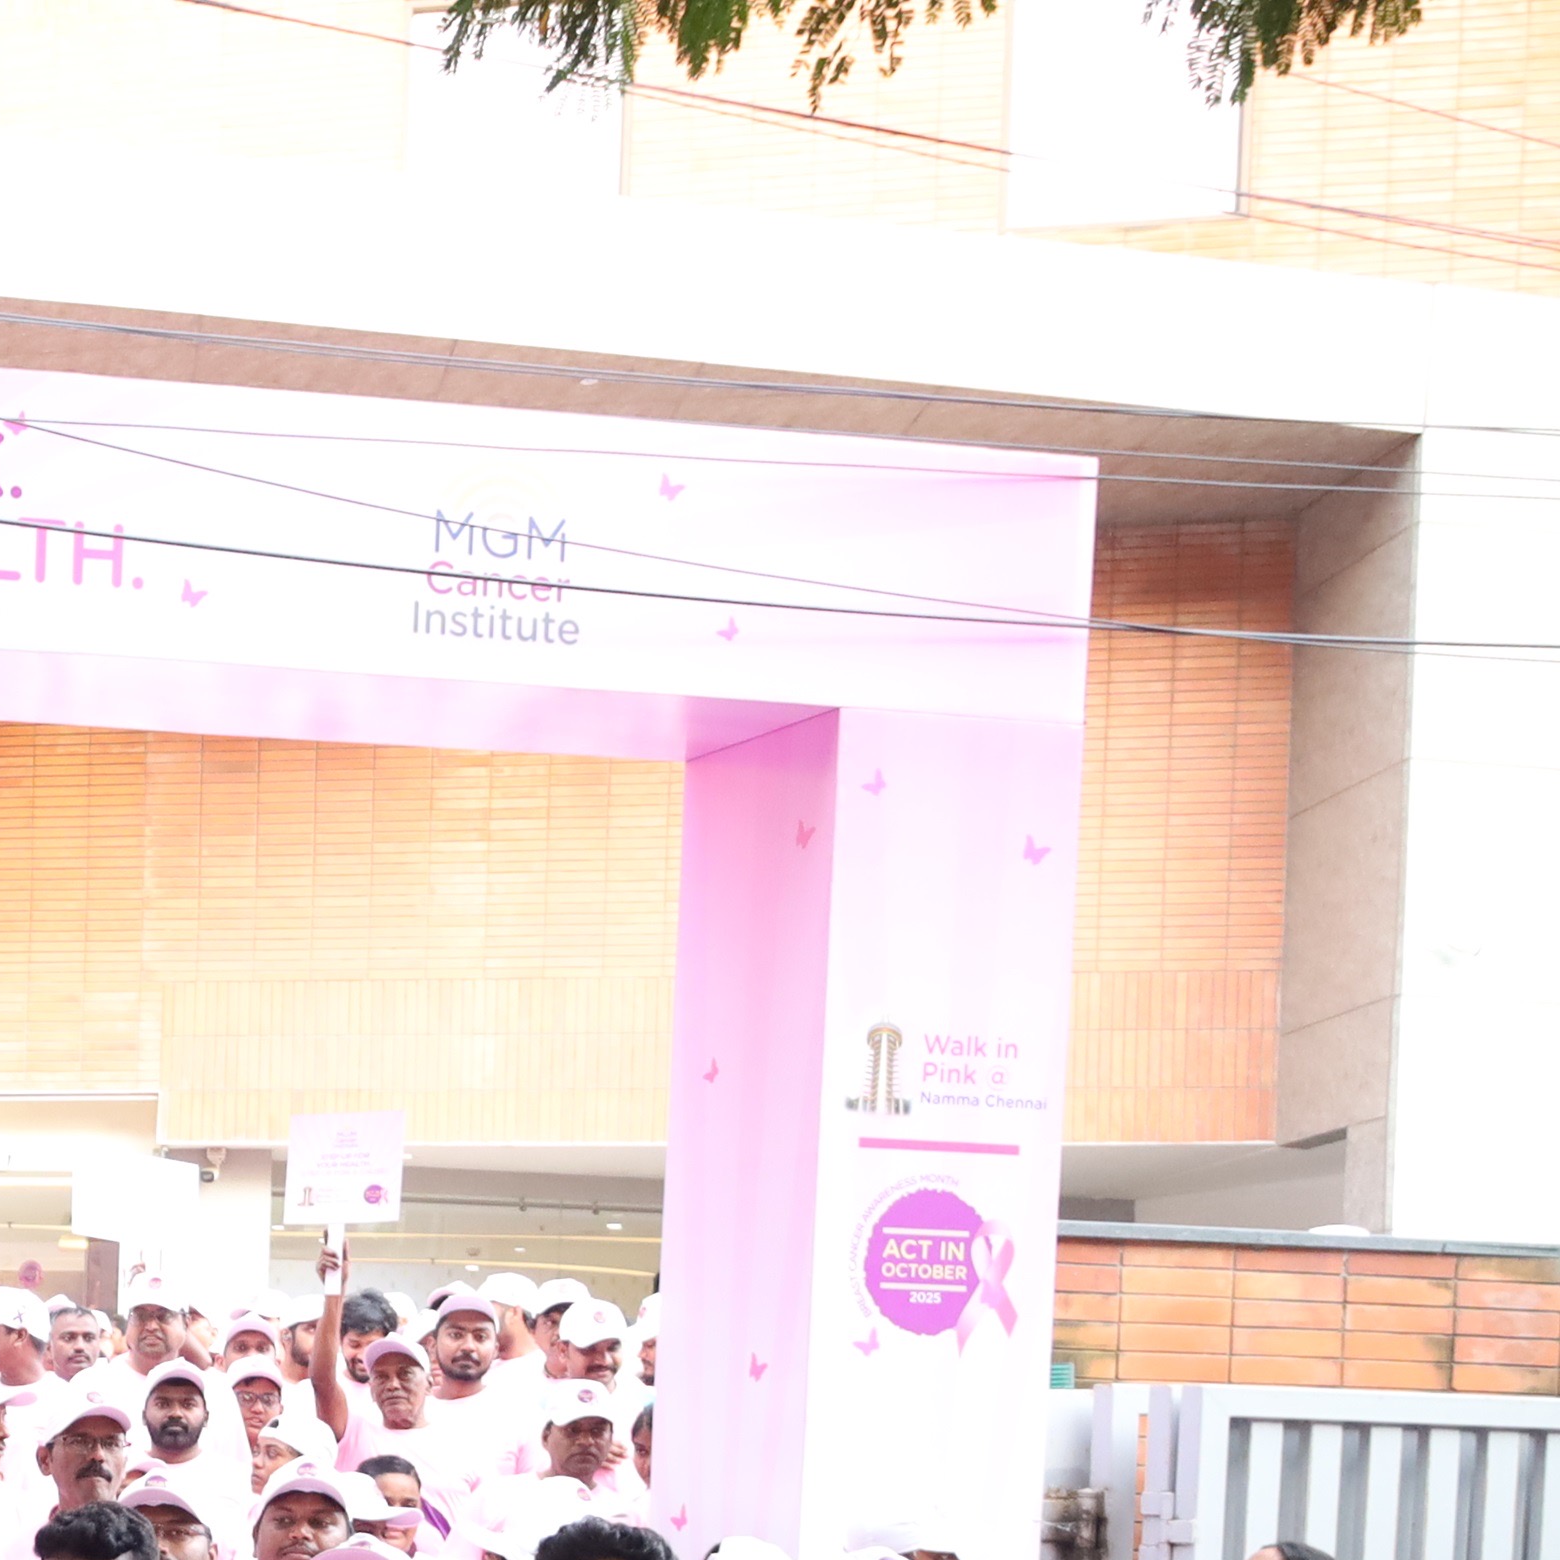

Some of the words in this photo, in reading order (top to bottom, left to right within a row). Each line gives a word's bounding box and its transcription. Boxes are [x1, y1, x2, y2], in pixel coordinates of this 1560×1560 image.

[434, 508, 566, 563] MGM
[426, 560, 571, 603] Cancer
[412, 600, 580, 646] Institute
[923, 1033, 987, 1058] Walk
[996, 1036, 1019, 1059] in
[922, 1062, 977, 1085] Pink
[920, 1091, 980, 1107] Namma
[985, 1094, 1048, 1111] Chennai
[919, 1173, 960, 1187] MONTH
[881, 1238, 933, 1261] ACT
[940, 1240, 966, 1262] IN
[881, 1262, 968, 1281] OCTOBER
[908, 1291, 942, 1304] 2025
